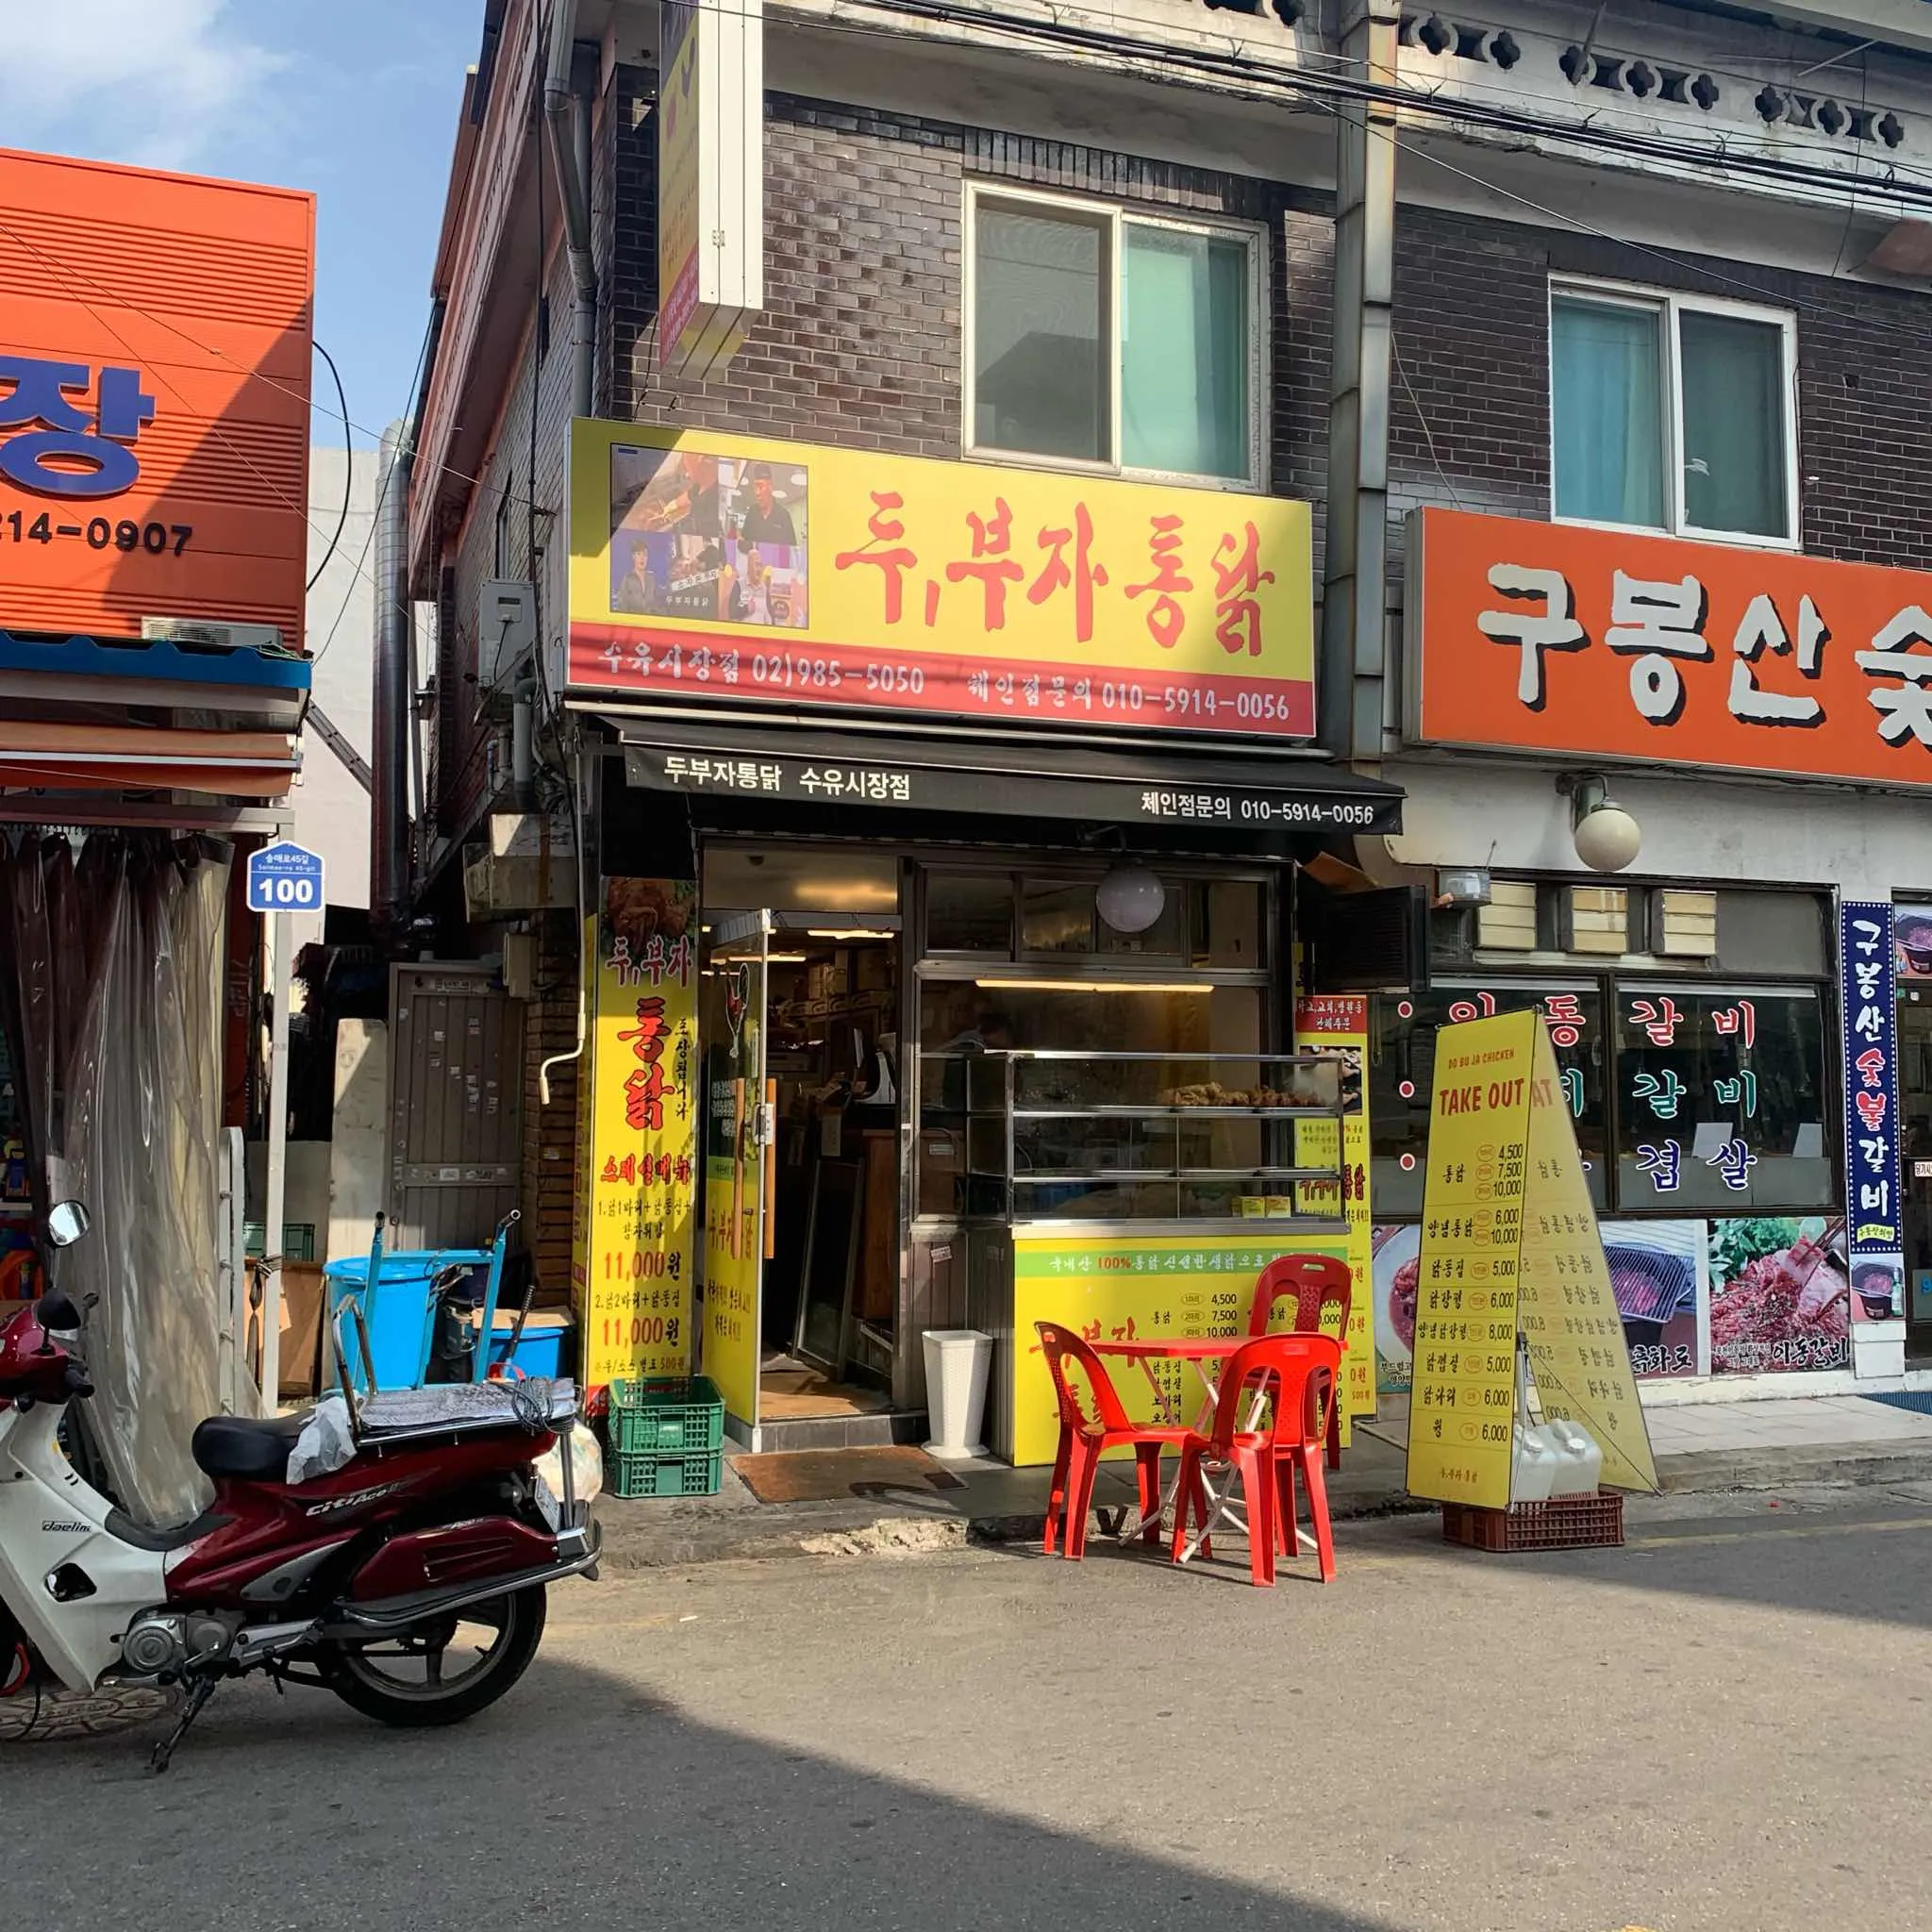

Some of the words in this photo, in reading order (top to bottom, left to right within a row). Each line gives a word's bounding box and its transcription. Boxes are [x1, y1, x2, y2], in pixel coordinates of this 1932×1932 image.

[0, 510, 192, 558] 14-0907
[598, 641, 739, 684] 수유시장점
[752, 652, 924, 694] 02)985-5050
[967, 670, 1092, 710] 체인점문의
[1101, 682, 1290, 721] 010-5914-0056
[664, 756, 782, 791] 두부자통닭
[799, 768, 911, 801] 수유시장점
[1141, 791, 1231, 820] 체인점문의
[1241, 799, 1374, 825] 010-5914-0056
[258, 878, 313, 903] 100
[618, 996, 675, 1131] 통닭
[1482, 1048, 1514, 1064] CHICKEN
[1852, 920, 1889, 1217] 구봉산숯불갈비
[1440, 1085, 1482, 1116] TAKE
[1489, 1077, 1524, 1109] OUT
[1499, 1143, 1524, 1160] 4,500
[1498, 1161, 1522, 1178] 7,500
[1493, 1180, 1522, 1197] 10,000
[1496, 1208, 1519, 1225] 6,000
[1491, 1228, 1518, 1244] 10,000
[605, 1251, 682, 1282] 11,000원
[1096, 1253, 1130, 1270] 100%
[1493, 1260, 1515, 1276] 5,000
[1211, 1293, 1237, 1306] 4,500
[1491, 1291, 1514, 1309] 6,000
[1212, 1310, 1237, 1323] 7,500
[603, 1317, 679, 1348] 11,000원
[1207, 1326, 1238, 1338] 10,000
[1490, 1324, 1512, 1341] 8,000
[1773, 1335, 1849, 1367] 이동갈비
[1487, 1357, 1511, 1373] 5,000
[1484, 1389, 1509, 1407] 6,000
[1482, 1424, 1507, 1441] 6,000
[42, 1520, 91, 1532] daelim
